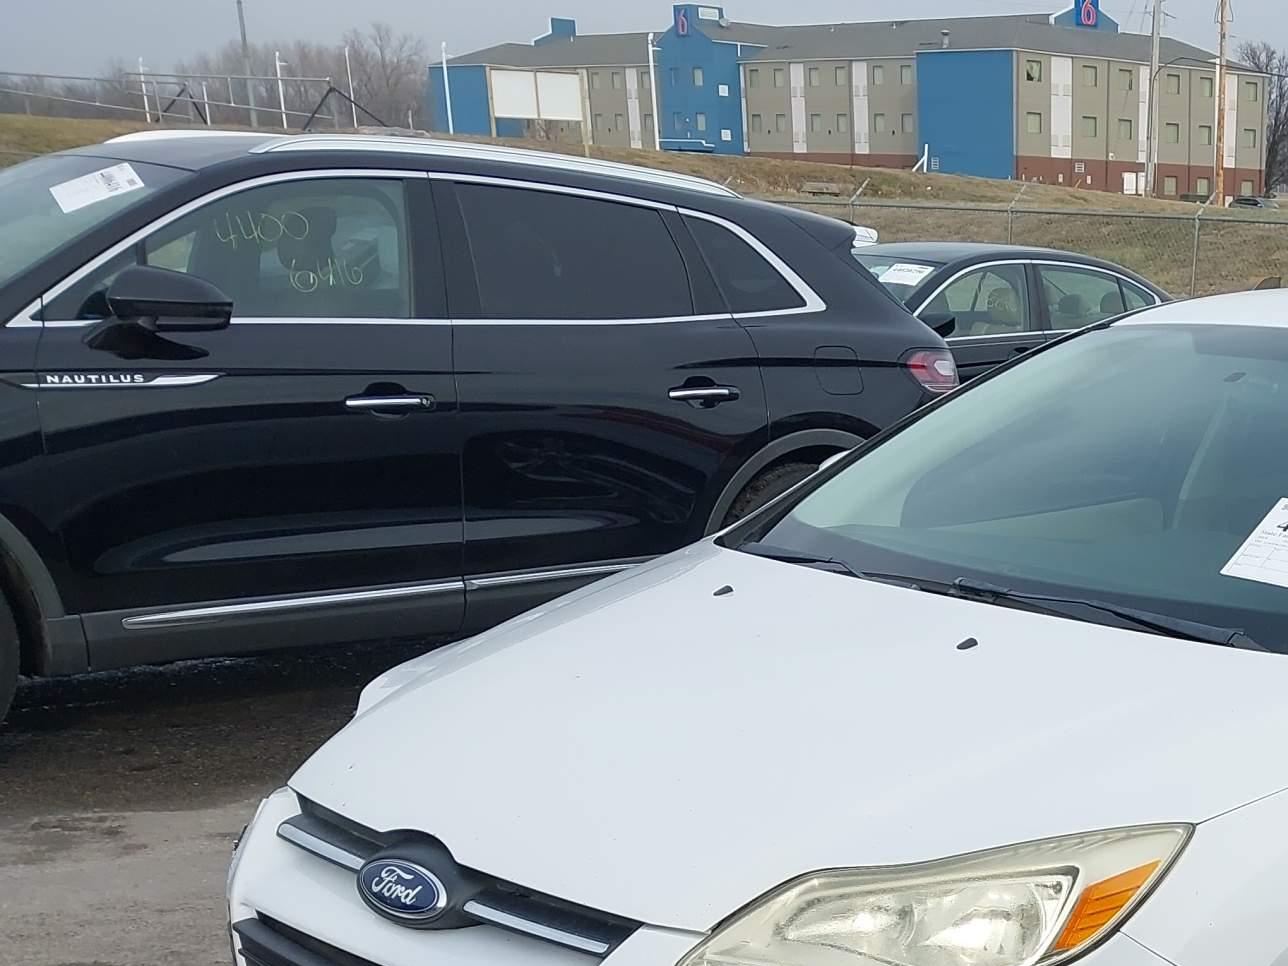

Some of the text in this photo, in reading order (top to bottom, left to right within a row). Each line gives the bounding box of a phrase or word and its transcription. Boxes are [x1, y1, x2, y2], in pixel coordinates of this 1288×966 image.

[677, 8, 688, 36] 6
[1081, 0, 1096, 25] 6
[214, 210, 309, 249] 4400
[46, 374, 144, 384] NAUTILUS
[371, 866, 422, 905] Ford
